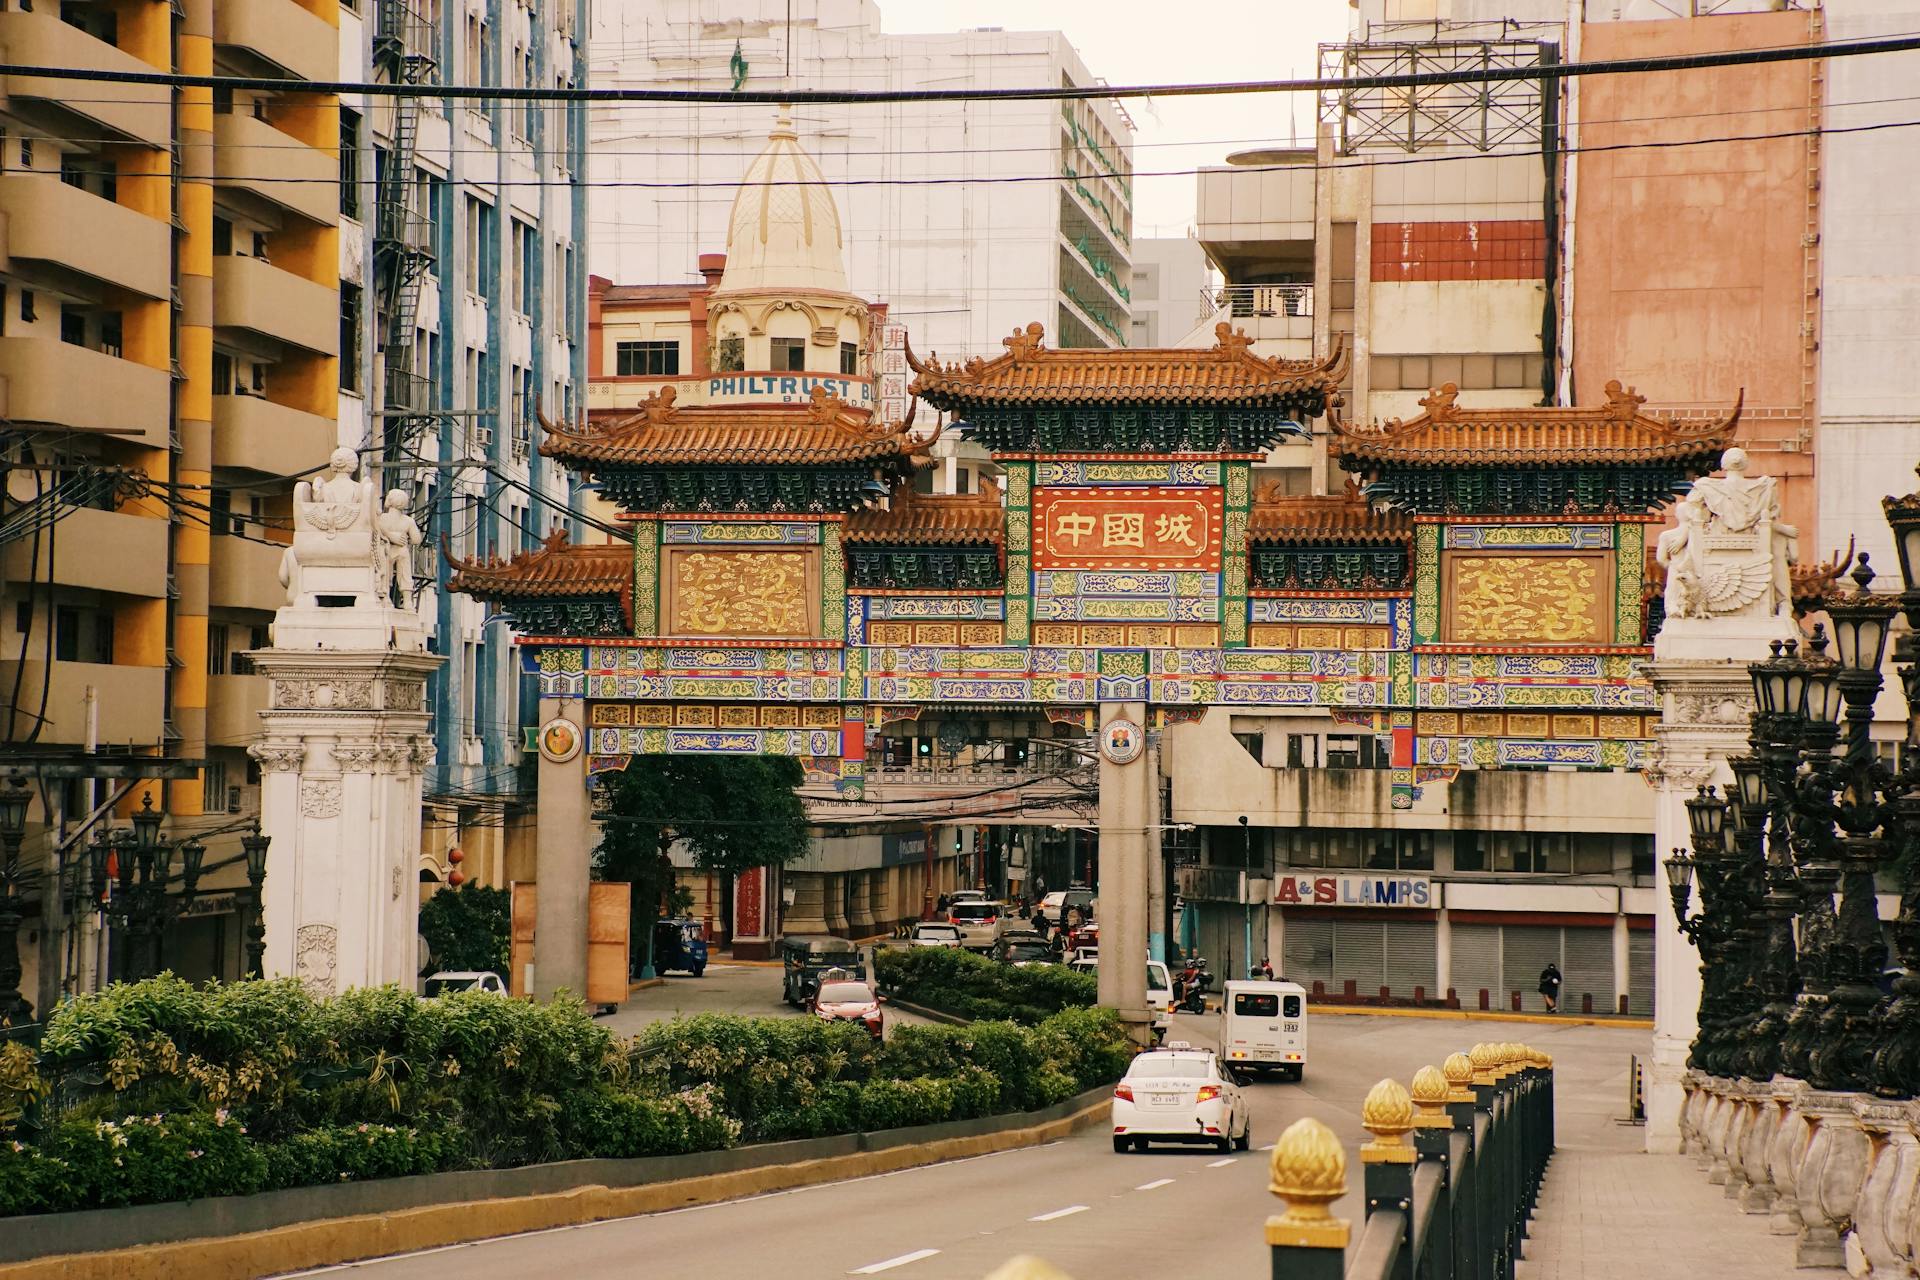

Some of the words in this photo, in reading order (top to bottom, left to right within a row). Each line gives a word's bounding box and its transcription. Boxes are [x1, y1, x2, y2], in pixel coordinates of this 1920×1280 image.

[710, 377, 850, 397] PHILTRUST
[1055, 511, 1198, 548] 中國城
[1343, 880, 1428, 905] LAMPS
